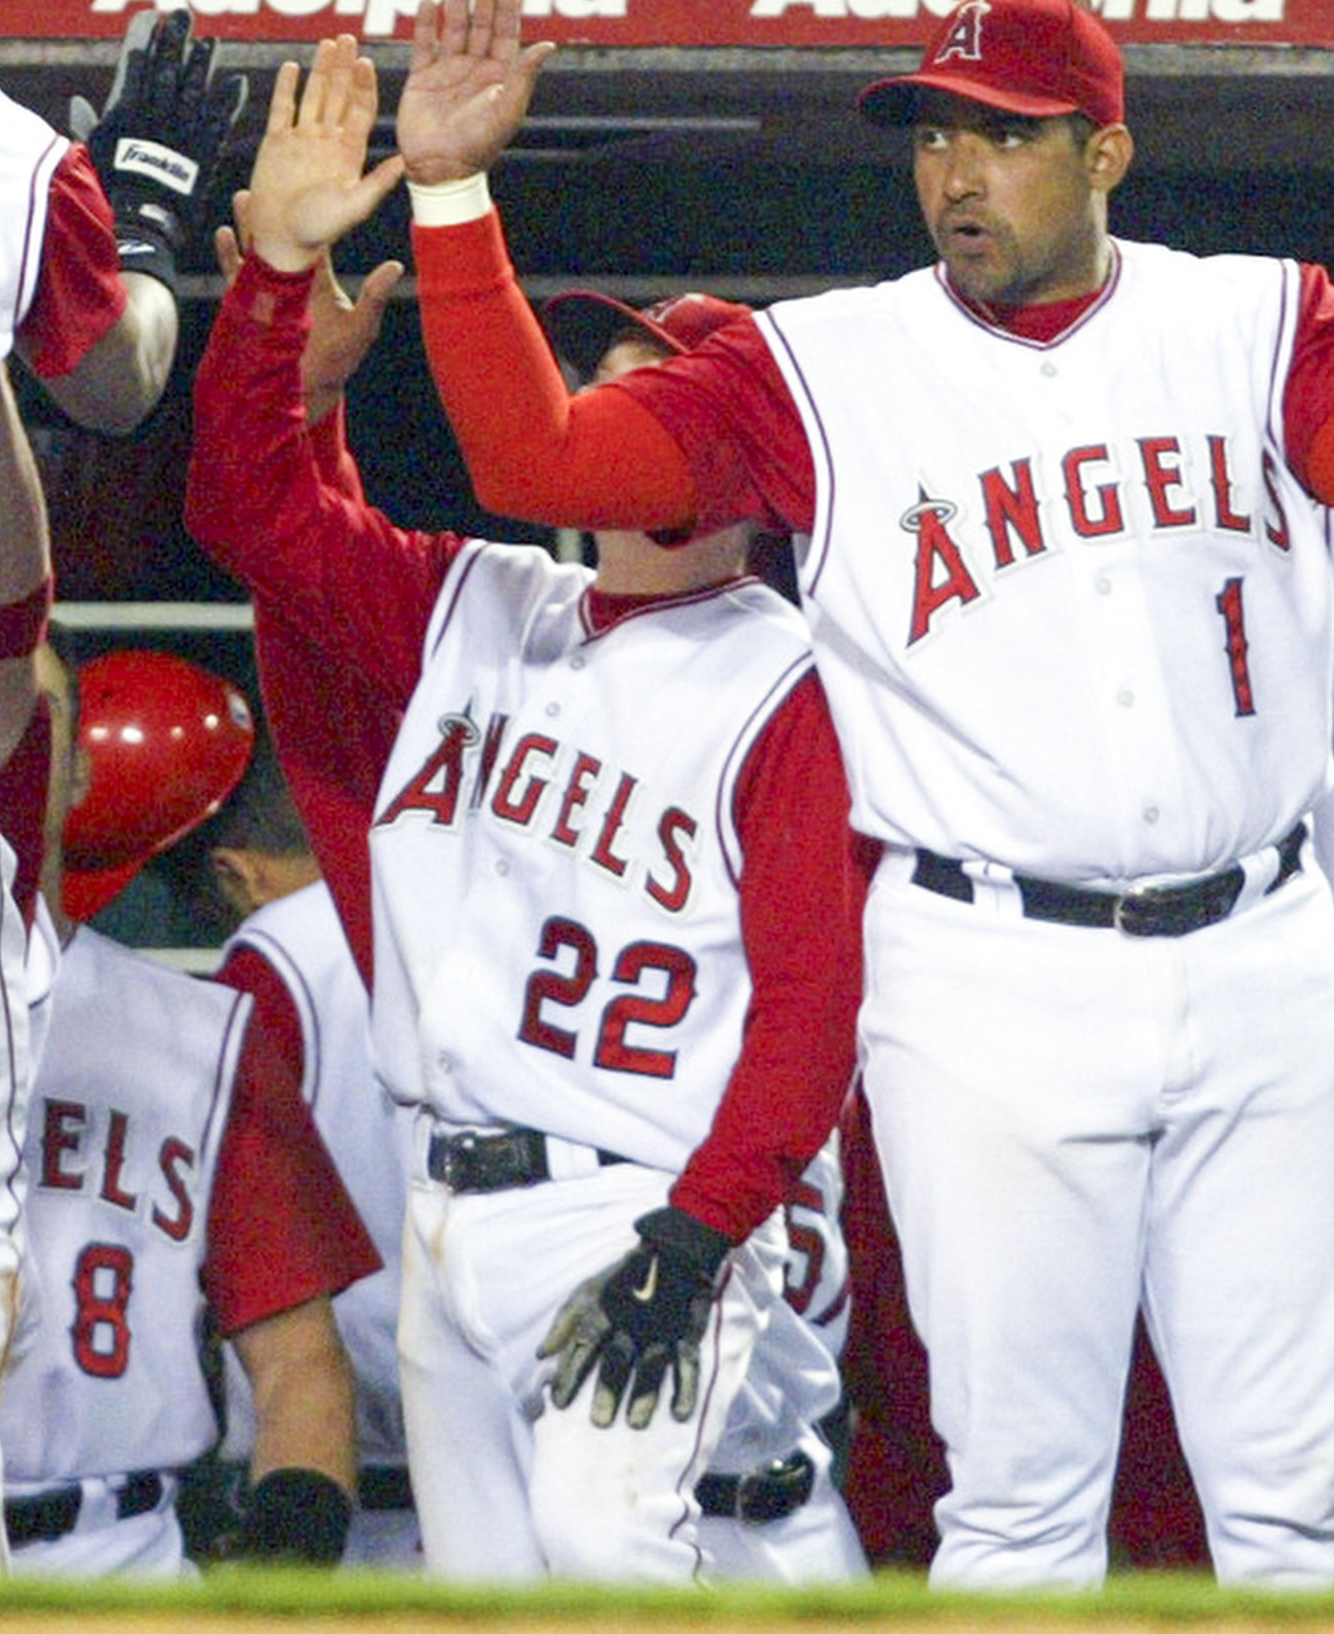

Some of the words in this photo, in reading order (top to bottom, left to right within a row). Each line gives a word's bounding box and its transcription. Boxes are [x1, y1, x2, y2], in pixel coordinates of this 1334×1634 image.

[1216, 577, 1256, 718] 1
[516, 915, 698, 1081] 22
[68, 1241, 135, 1379] 8
